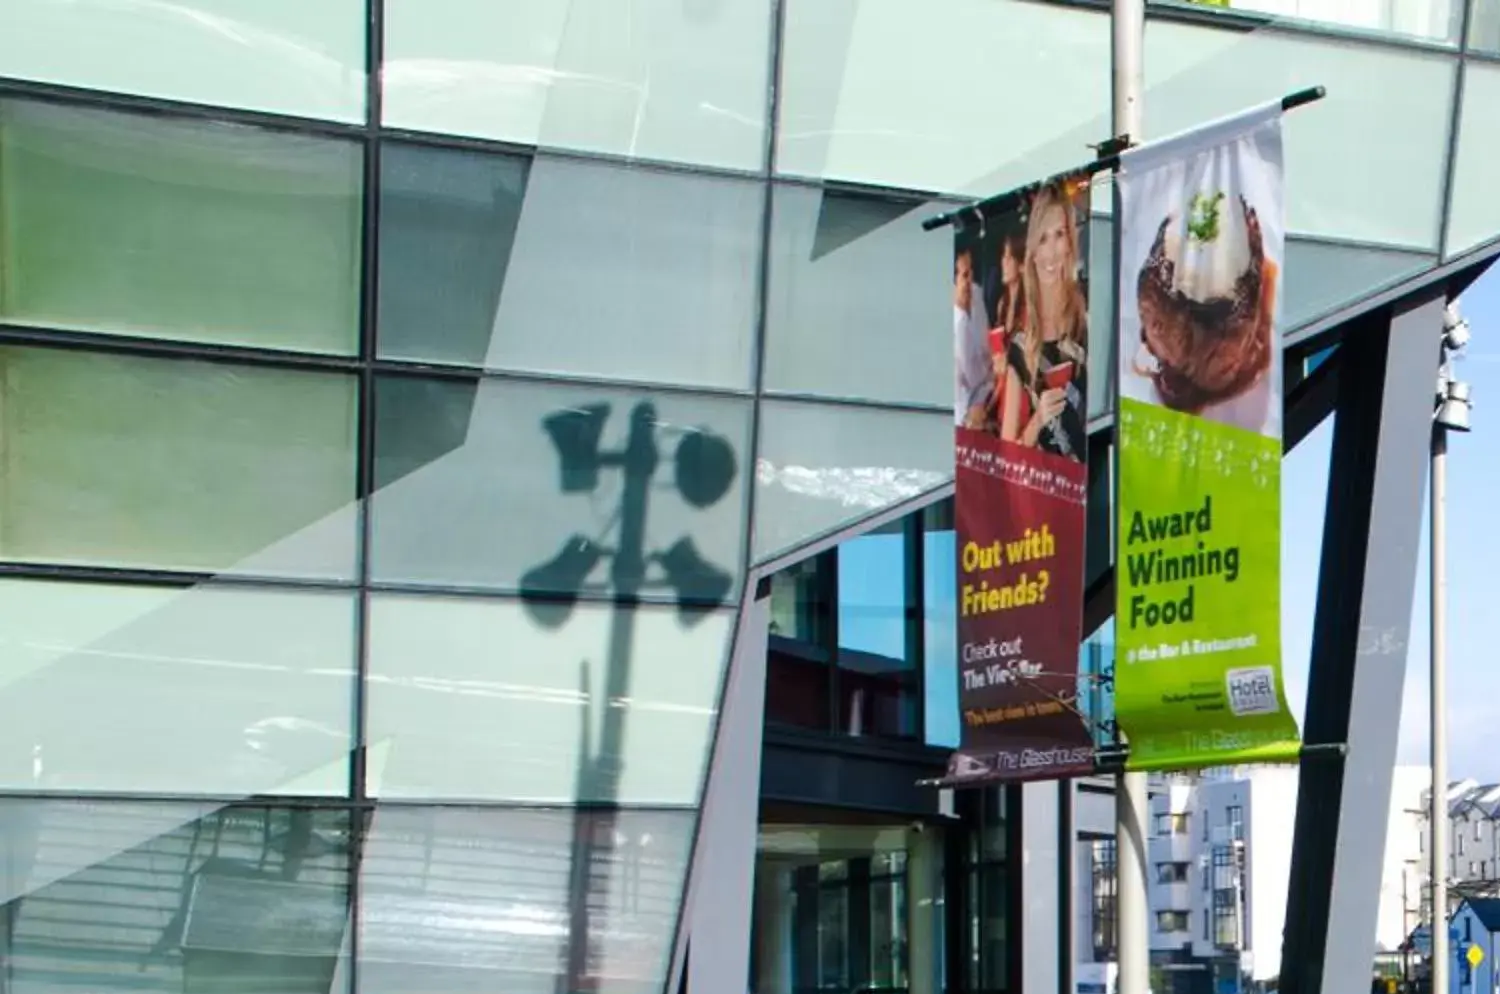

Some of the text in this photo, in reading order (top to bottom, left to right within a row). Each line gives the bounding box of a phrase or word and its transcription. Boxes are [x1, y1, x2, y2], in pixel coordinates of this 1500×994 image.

[1127, 494, 1212, 546] Award
[962, 524, 1055, 573] Out with
[1127, 541, 1240, 588] Winning
[962, 569, 1050, 617] Friends?
[1130, 584, 1195, 630] Food
[963, 635, 1023, 663] Check out
[963, 667, 985, 691] The
[1231, 675, 1273, 697] Hotel
[997, 745, 1088, 769] The Glasshouse
